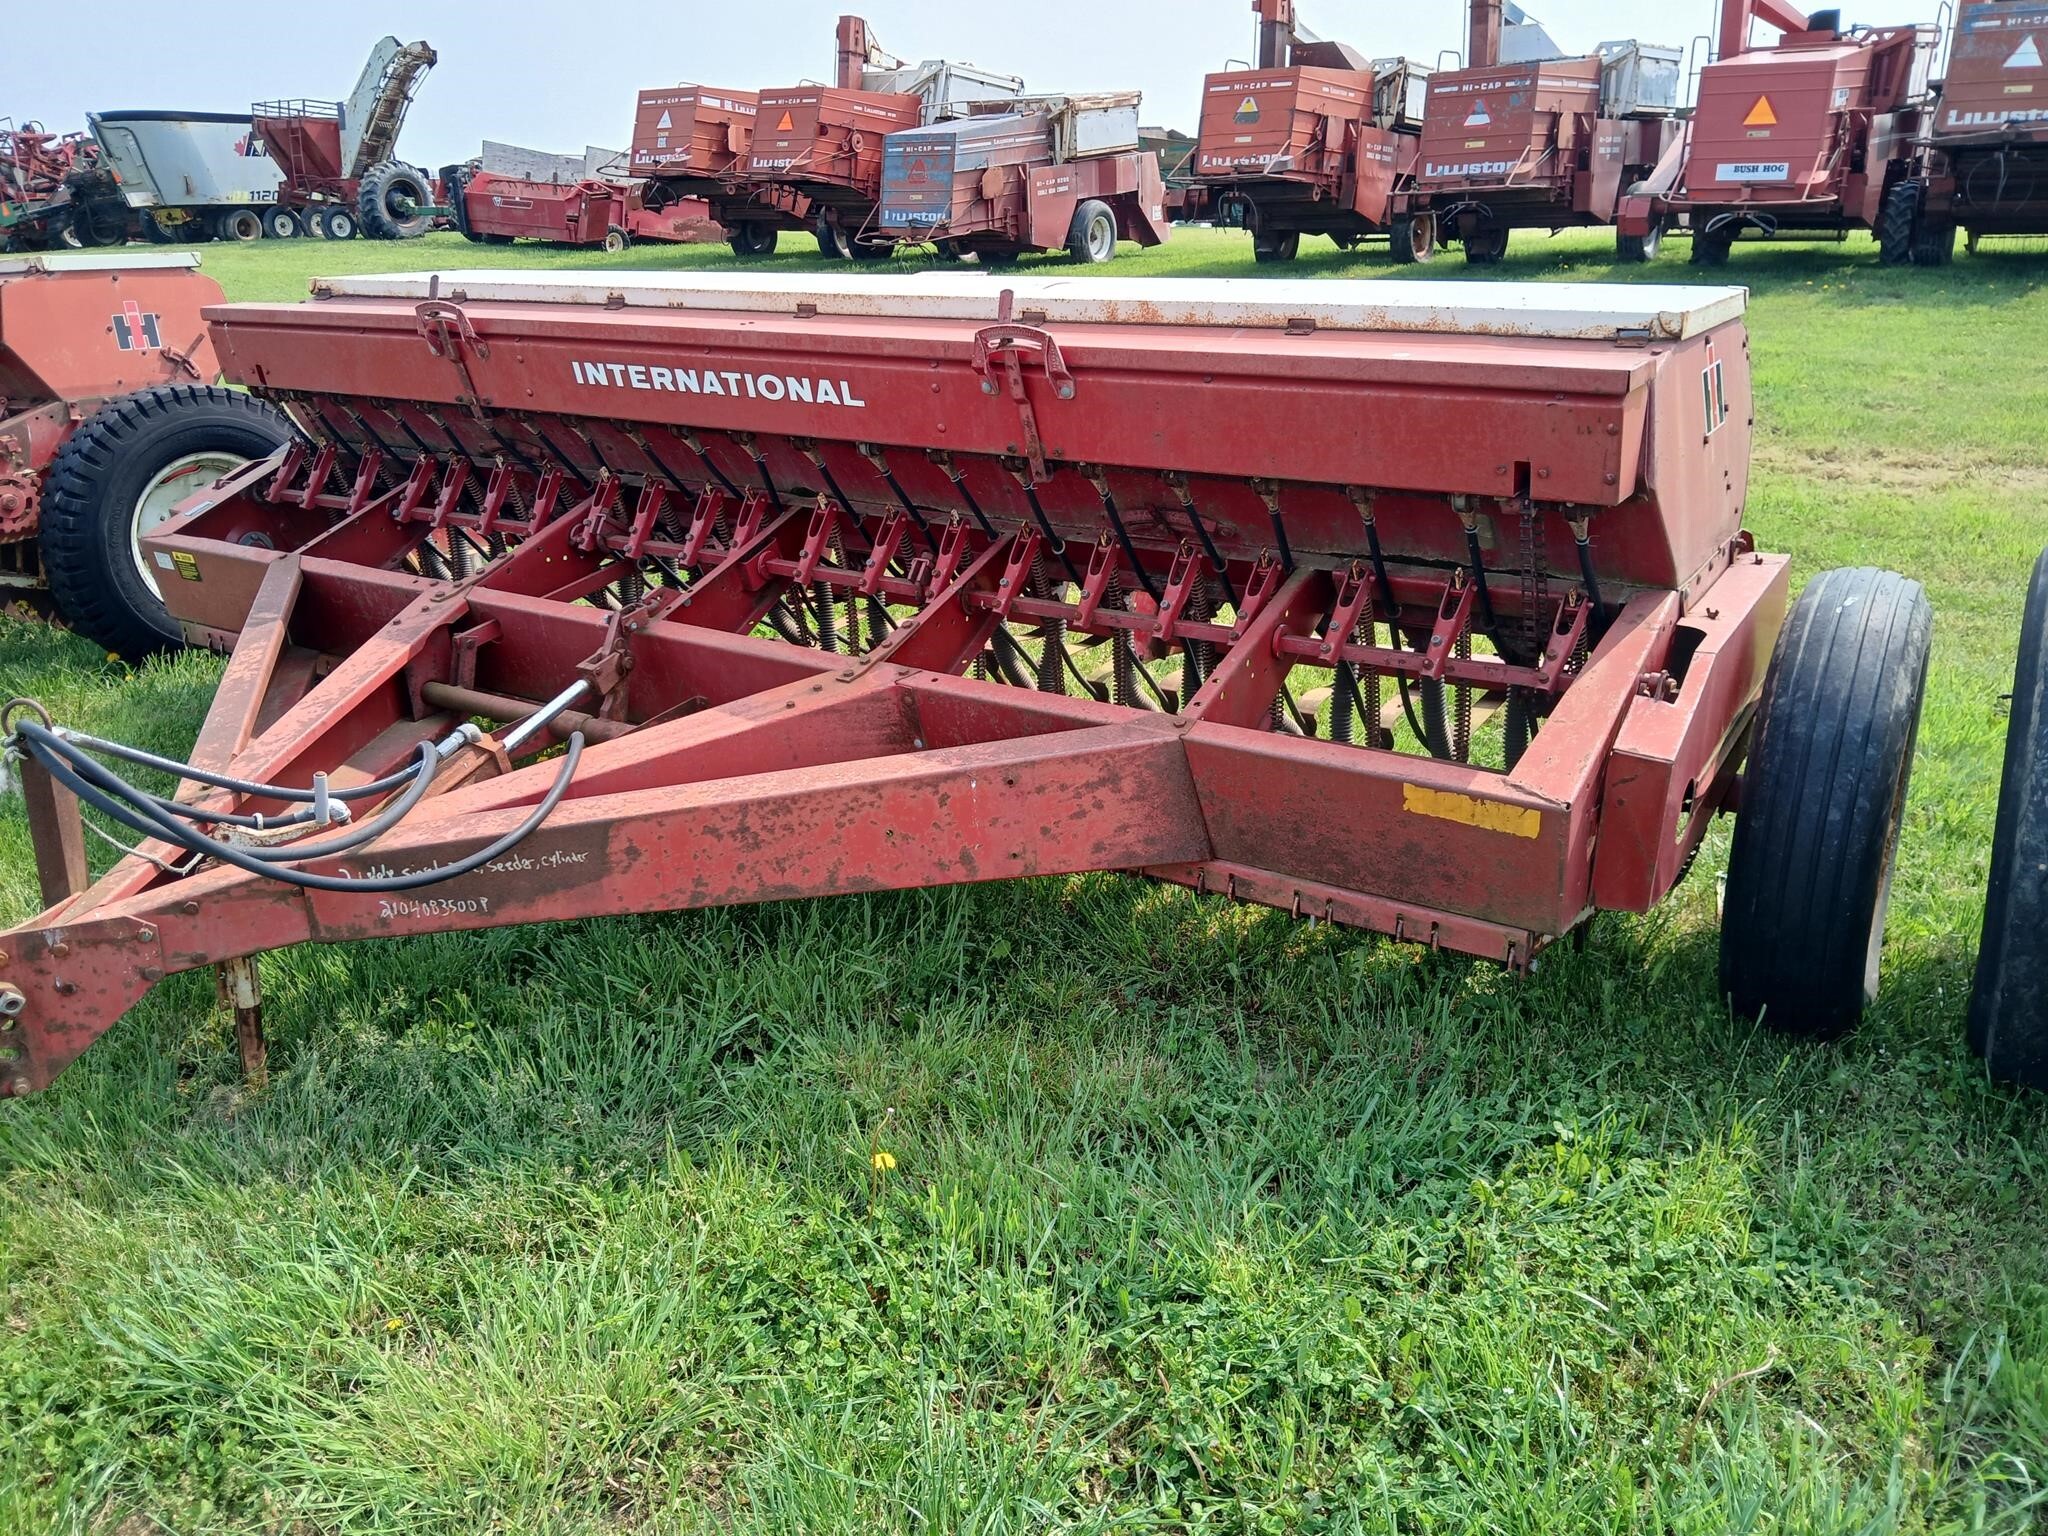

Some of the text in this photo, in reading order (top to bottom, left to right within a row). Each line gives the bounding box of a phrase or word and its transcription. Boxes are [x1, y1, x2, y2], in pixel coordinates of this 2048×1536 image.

[1234, 82, 1267, 91] HI-CAP
[1462, 81, 1502, 91] HI-CAP
[906, 145, 932, 153] HI-CAP
[1733, 164, 1785, 173] BUSH HOG
[571, 361, 866, 408] INTERNATIONAL
